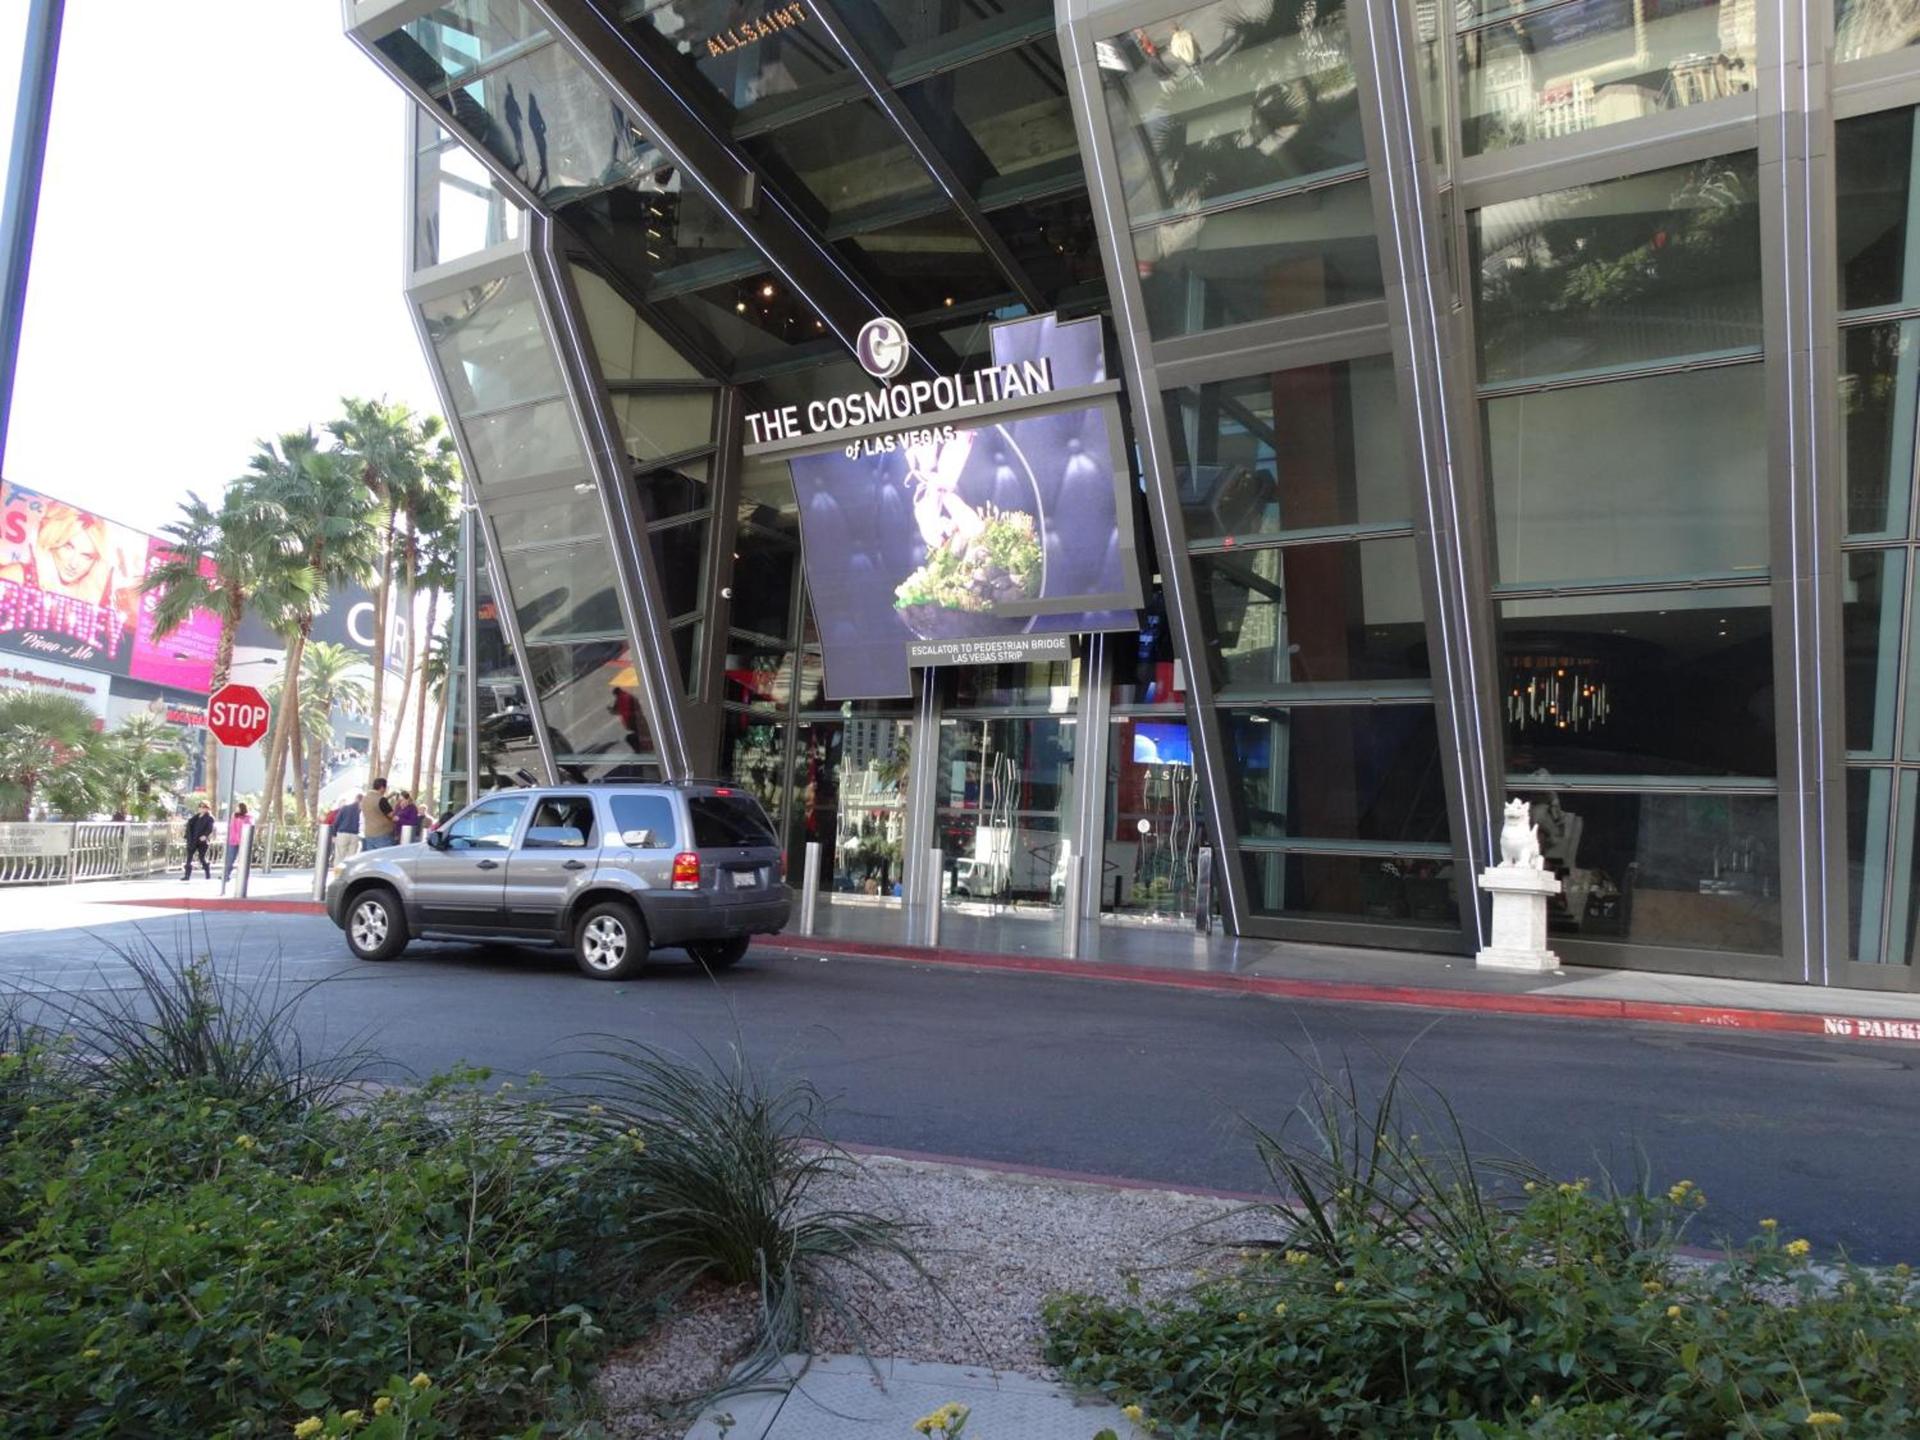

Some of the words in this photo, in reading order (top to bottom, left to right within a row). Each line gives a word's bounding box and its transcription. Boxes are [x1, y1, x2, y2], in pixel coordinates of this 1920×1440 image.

[745, 405, 802, 443] THE
[808, 357, 1053, 432] COSMOPOLITAN
[845, 439, 862, 459] of
[865, 434, 894, 456] LAS
[899, 425, 954, 451] VEGAS
[912, 644, 958, 656] ESCALATOR
[961, 643, 971, 653] TO
[974, 640, 1029, 651] PEDESTRIAN
[1031, 638, 1066, 649] BRIDGE
[952, 652, 968, 663] LAS
[969, 651, 997, 663] VEGAS
[998, 651, 1023, 662] STRIP
[211, 702, 266, 730] STOP
[1823, 1017, 1852, 1035] NO
